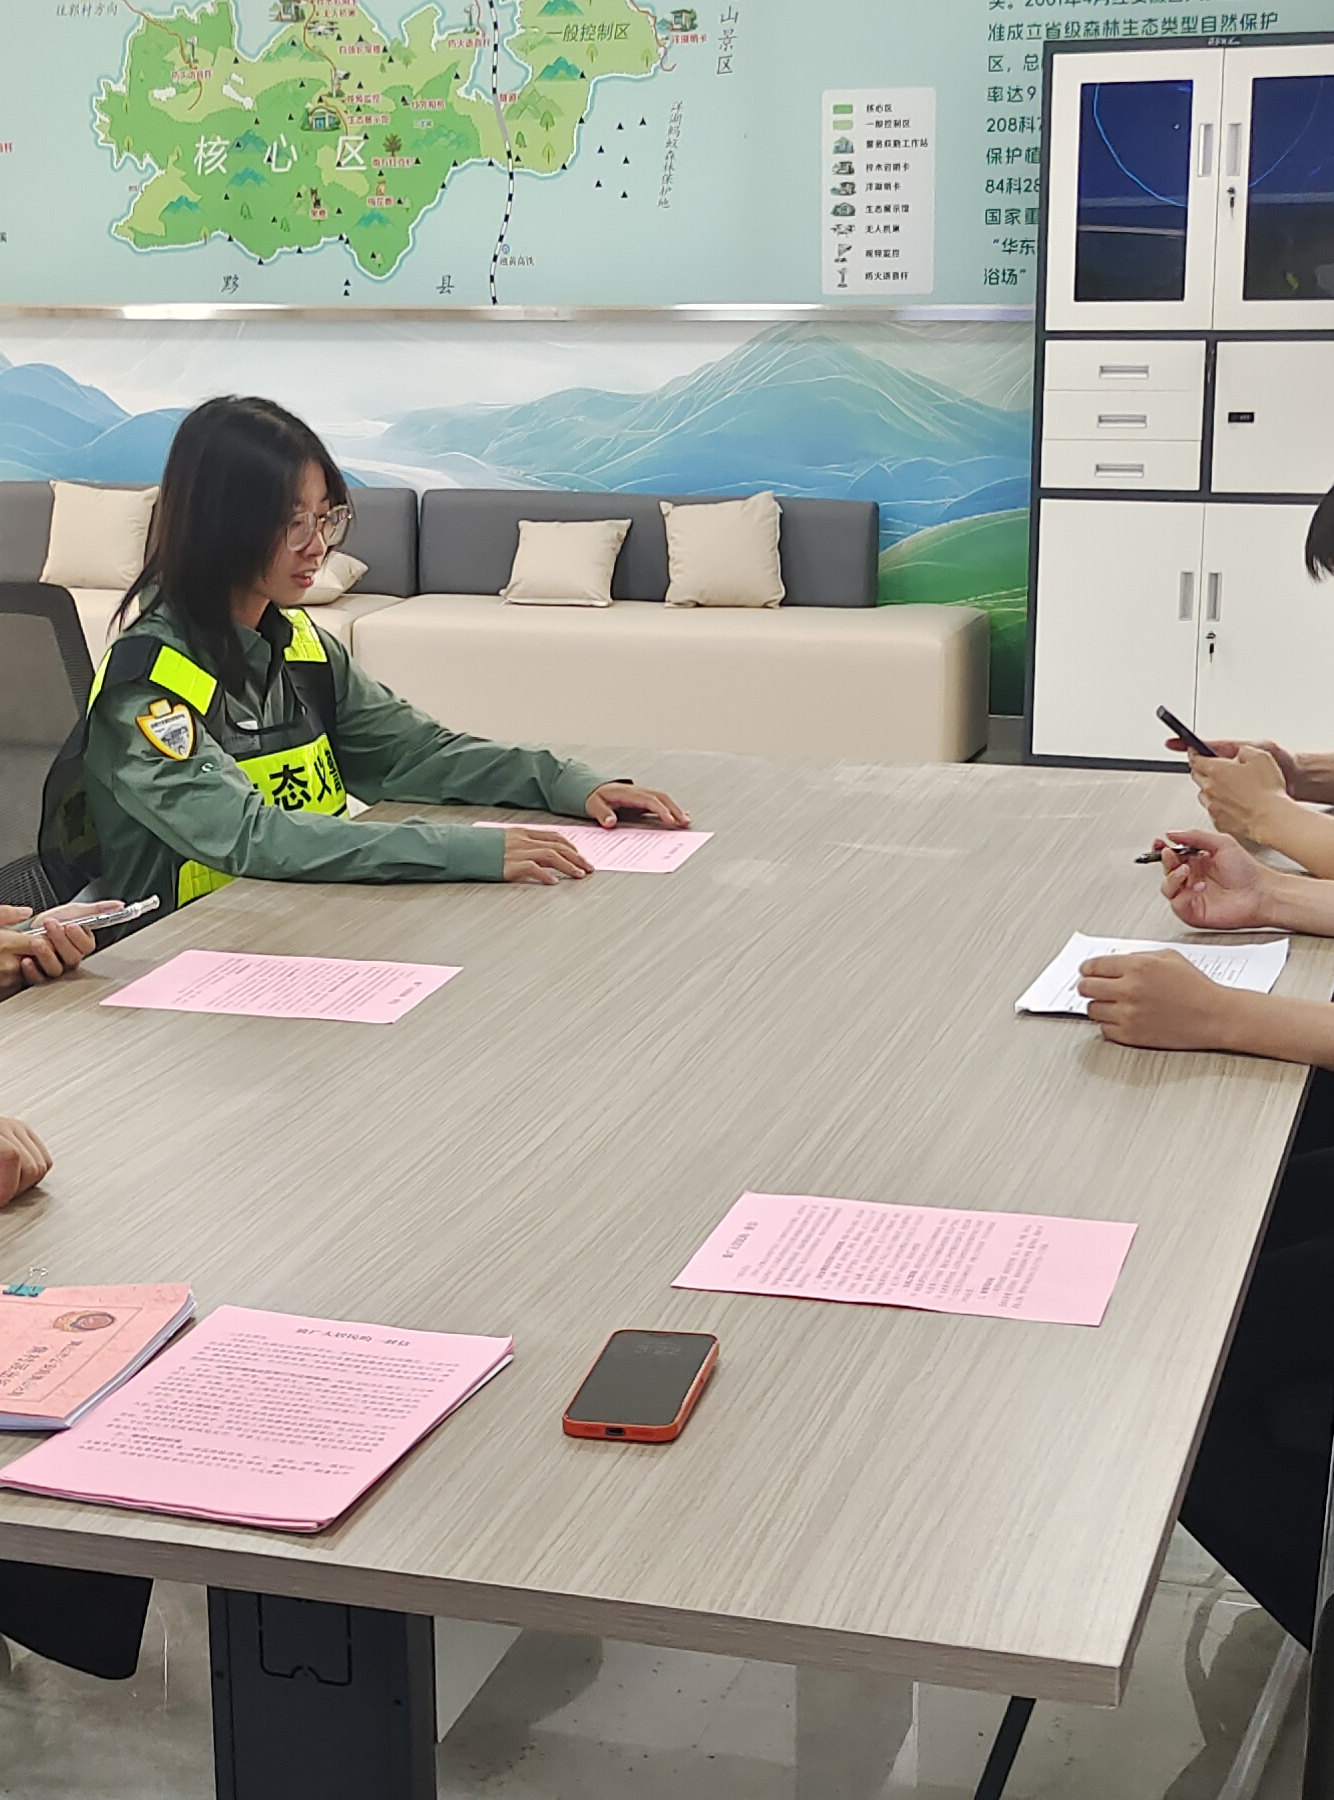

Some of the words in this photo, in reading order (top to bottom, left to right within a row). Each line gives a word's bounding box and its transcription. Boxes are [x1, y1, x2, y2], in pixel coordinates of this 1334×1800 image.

[546, 23, 630, 42] 一般控制区
[988, 12, 1278, 42] 准成立省级森林生态类型自然保护
[987, 85, 1037, 103] 率达9
[866, 104, 892, 112] 核心区
[865, 119, 910, 128] 一般控制区
[193, 132, 367, 175] 核心区
[436, 275, 456, 295] 县
[983, 268, 1026, 286] 浴场”
